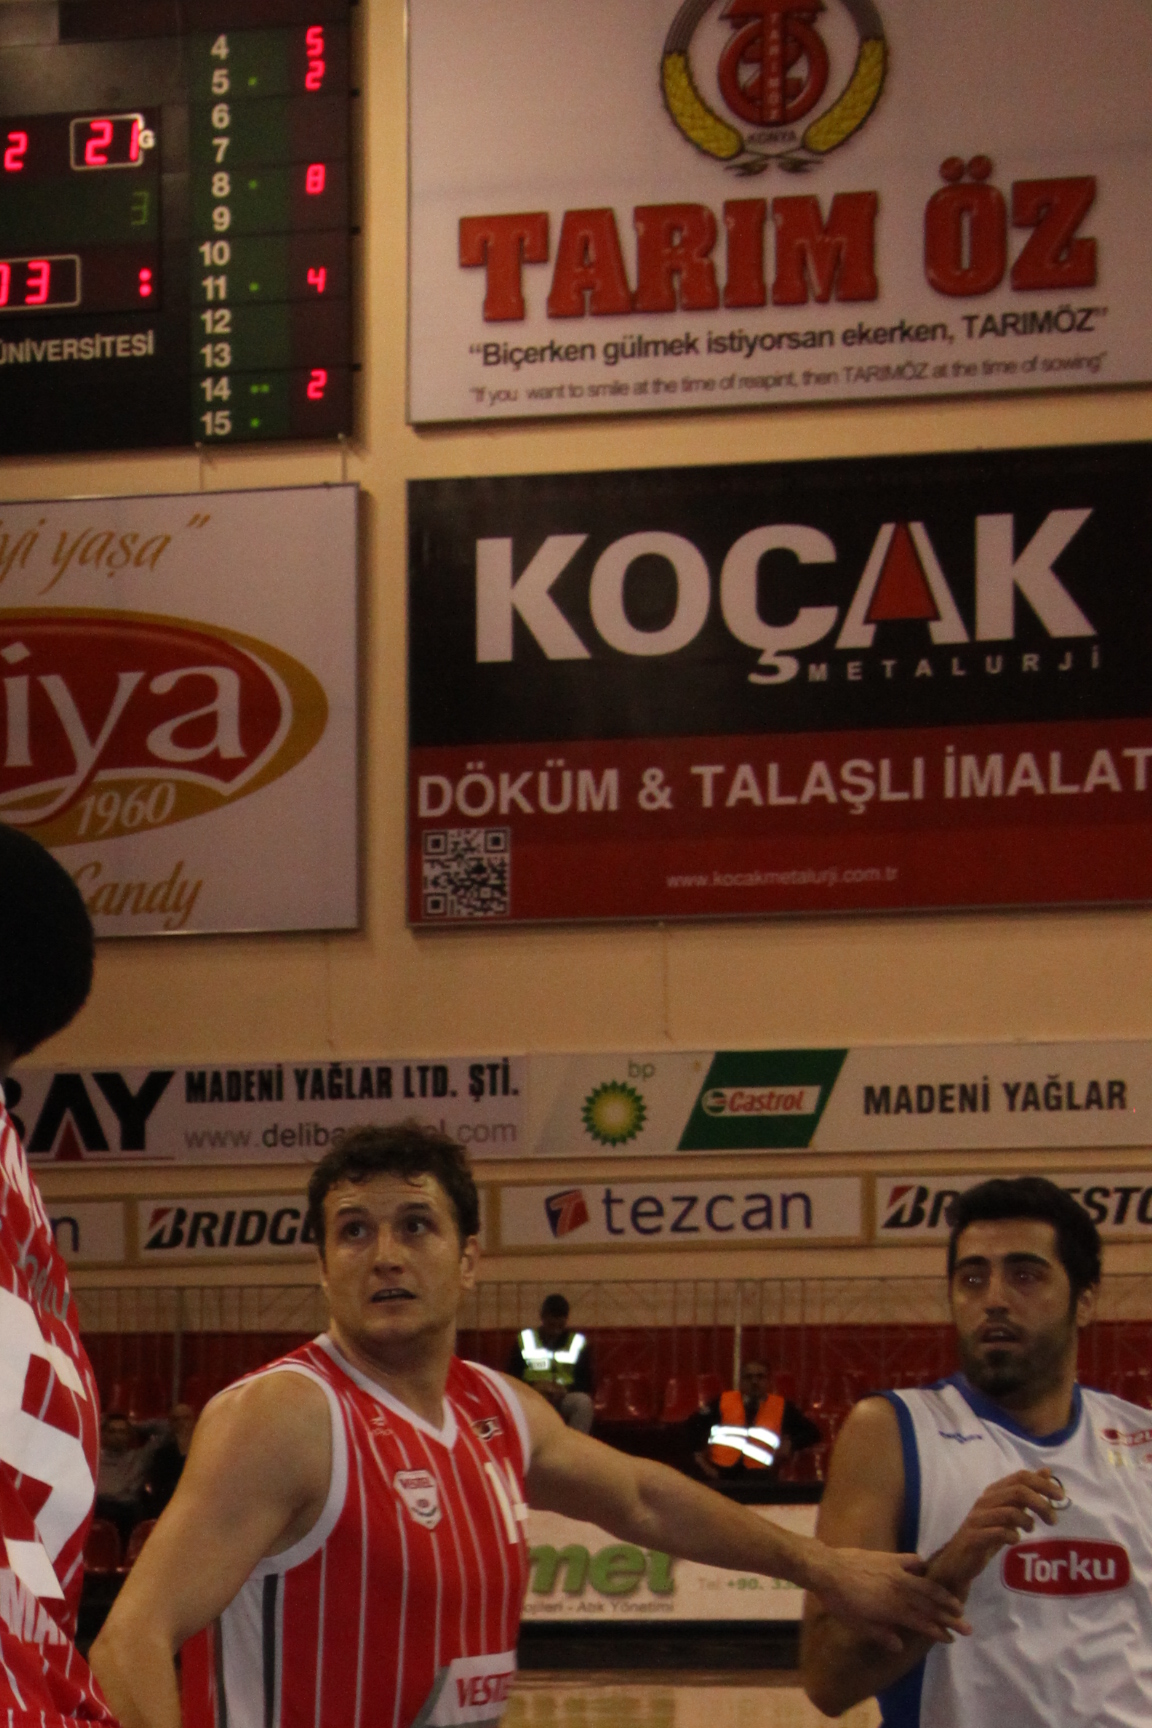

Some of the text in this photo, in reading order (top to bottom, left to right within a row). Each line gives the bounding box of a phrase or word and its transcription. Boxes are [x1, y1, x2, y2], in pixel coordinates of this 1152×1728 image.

[210, 33, 230, 60] 4
[306, 25, 325, 57] 5
[211, 68, 230, 95] 5
[305, 59, 326, 92] 2
[211, 103, 231, 129] 6
[3, 129, 28, 172] 2
[84, 119, 141, 165] 21
[211, 137, 231, 163] 7
[211, 171, 231, 197] 8
[305, 162, 327, 195] 8
[211, 205, 231, 232] 9
[199, 241, 231, 266] 10
[459, 155, 1097, 322] TARIM ÖZ
[201, 275, 228, 301] 11
[306, 266, 327, 293] 4
[201, 308, 231, 334] 12
[200, 342, 232, 368] 13
[603, 333, 699, 366] gülmek
[706, 328, 835, 358] istiyorsan
[841, 319, 955, 346] ekerken,
[200, 376, 231, 402] 14
[307, 367, 327, 400] 2
[567, 383, 585, 398] to
[652, 378, 679, 394] the
[681, 376, 715, 393] time
[951, 361, 976, 377] the
[982, 358, 1018, 376] time
[200, 410, 232, 436] 15
[475, 507, 1099, 686] KOÇAK
[808, 644, 1103, 684] METALURJİ
[416, 759, 620, 820] DÖKÜM
[638, 766, 674, 811] &
[691, 756, 926, 817] TALAŞLI
[77, 782, 177, 836] 1960
[184, 1058, 520, 1104] MADENİ YAĞLAR LTD. ŞTİ.
[627, 1060, 656, 1080] bp
[728, 1089, 805, 1112] Castrol
[862, 1074, 1128, 1116] MADENİ YAĞLAR
[603, 1187, 814, 1236] tezcan
[1016, 1551, 1117, 1583] Torku
